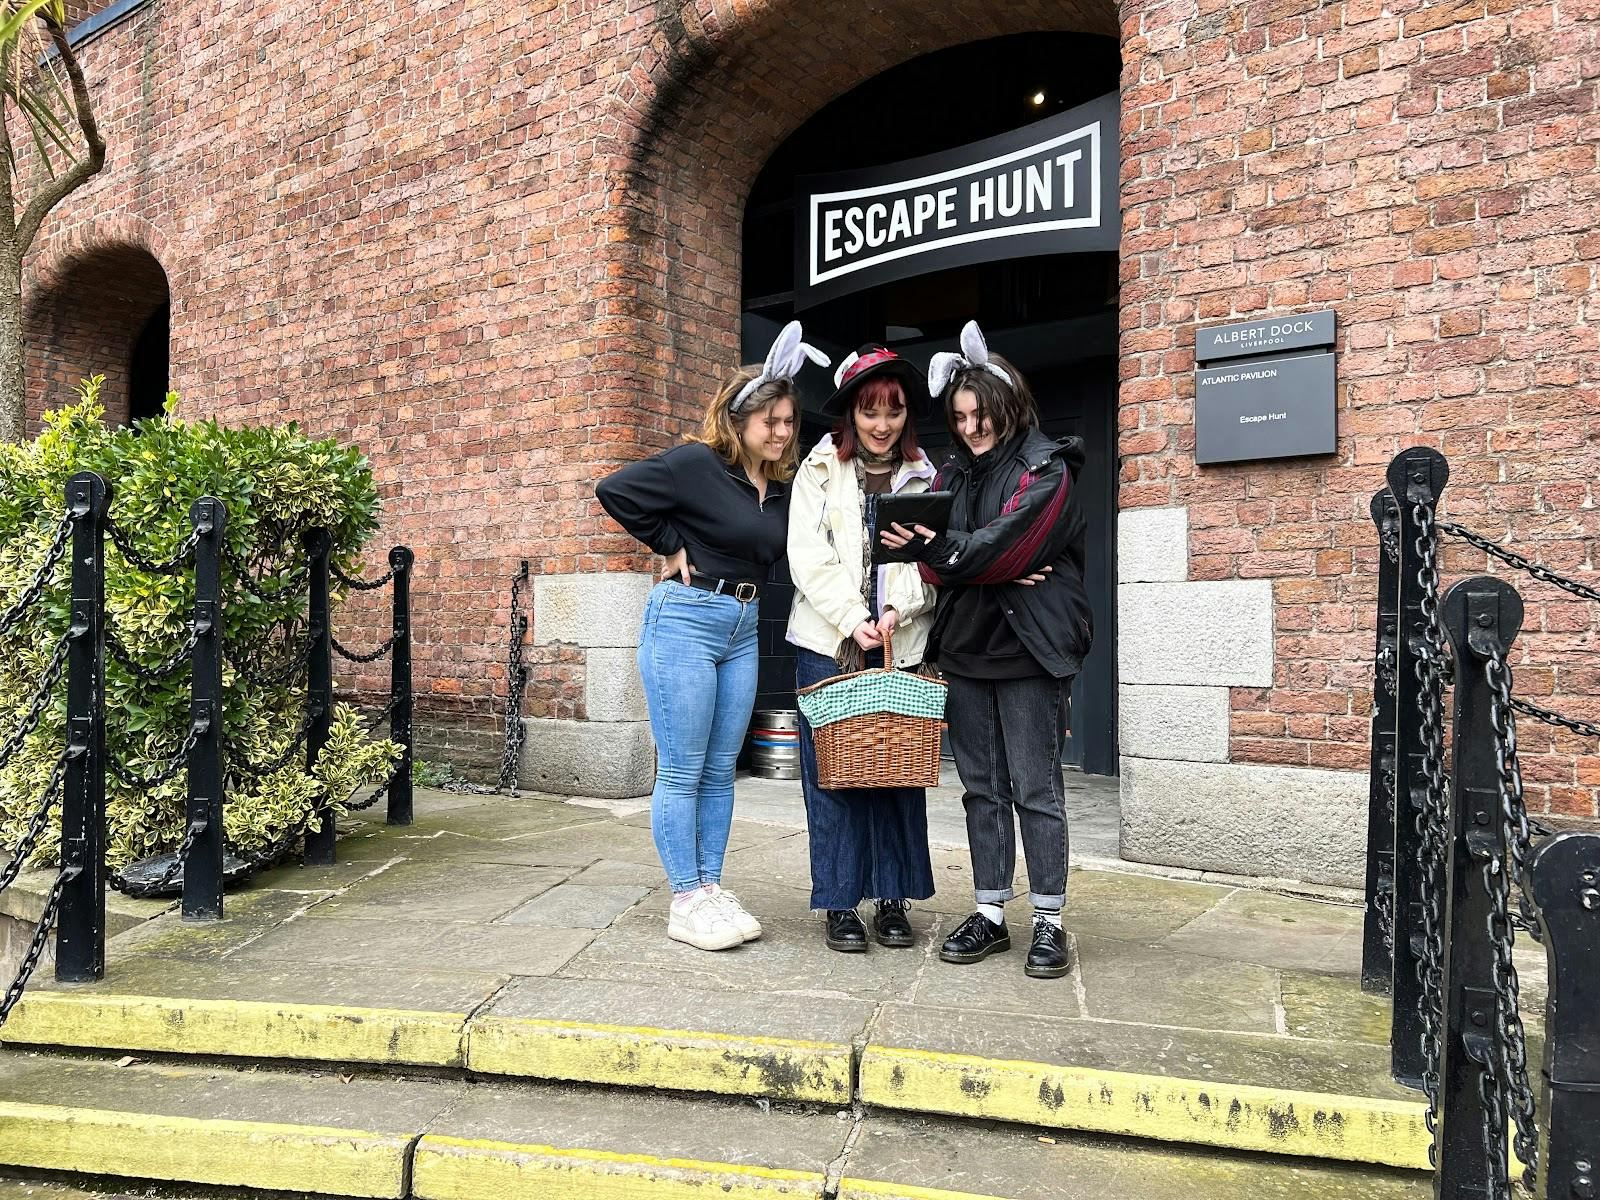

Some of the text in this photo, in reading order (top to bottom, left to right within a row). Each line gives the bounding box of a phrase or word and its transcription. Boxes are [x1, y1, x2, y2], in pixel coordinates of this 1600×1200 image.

[824, 149, 1082, 263] ESCAPE HUNT
[1214, 320, 1314, 344] ALBERT DOCK
[1240, 337, 1285, 348] LIVERPOOL
[1201, 369, 1277, 385] ATLANTIC PAVILION
[1240, 412, 1287, 423] Escape Hunt
